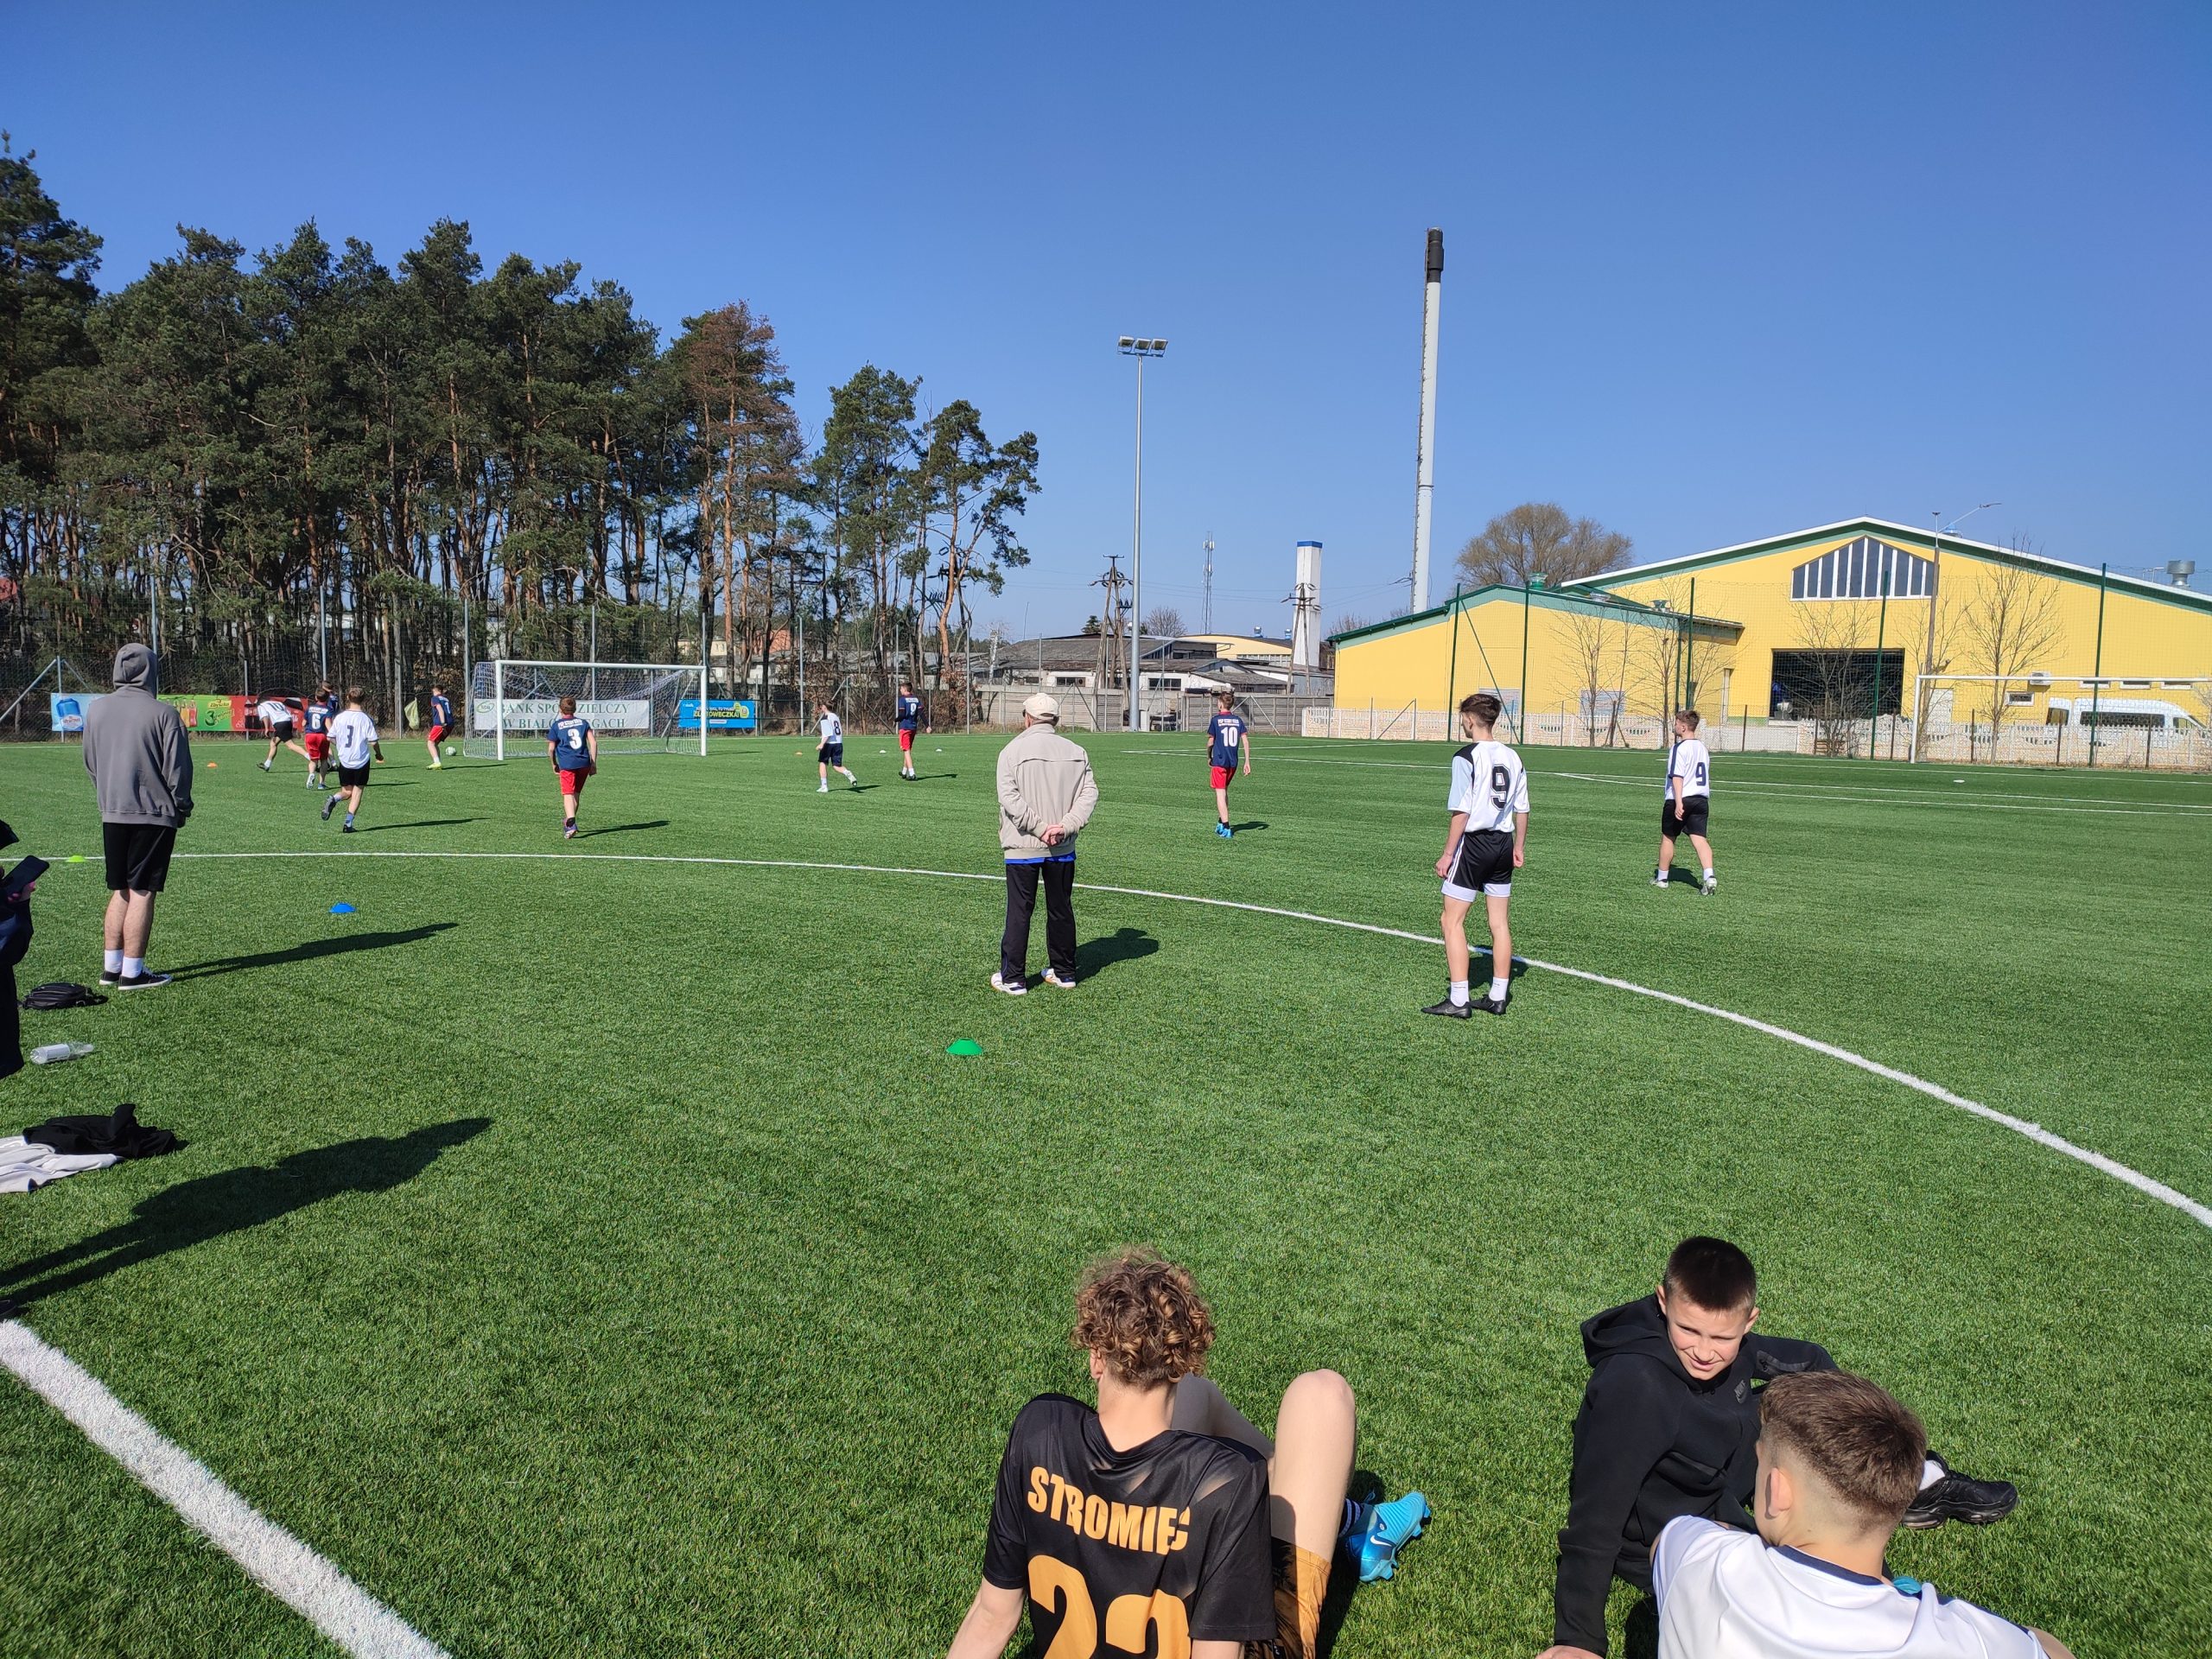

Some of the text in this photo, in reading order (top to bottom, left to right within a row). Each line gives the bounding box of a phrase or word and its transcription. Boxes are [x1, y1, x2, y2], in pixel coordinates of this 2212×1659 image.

[267, 702, 284, 711] 10
[537, 700, 630, 714] SPÓZIELCZY
[312, 713, 321, 729] 6
[834, 721, 841, 735] 8
[345, 724, 354, 748] 3
[567, 728, 582, 750] 3
[1221, 727, 1238, 747] 10
[1695, 761, 1707, 786] 9
[1491, 764, 1511, 811] 9
